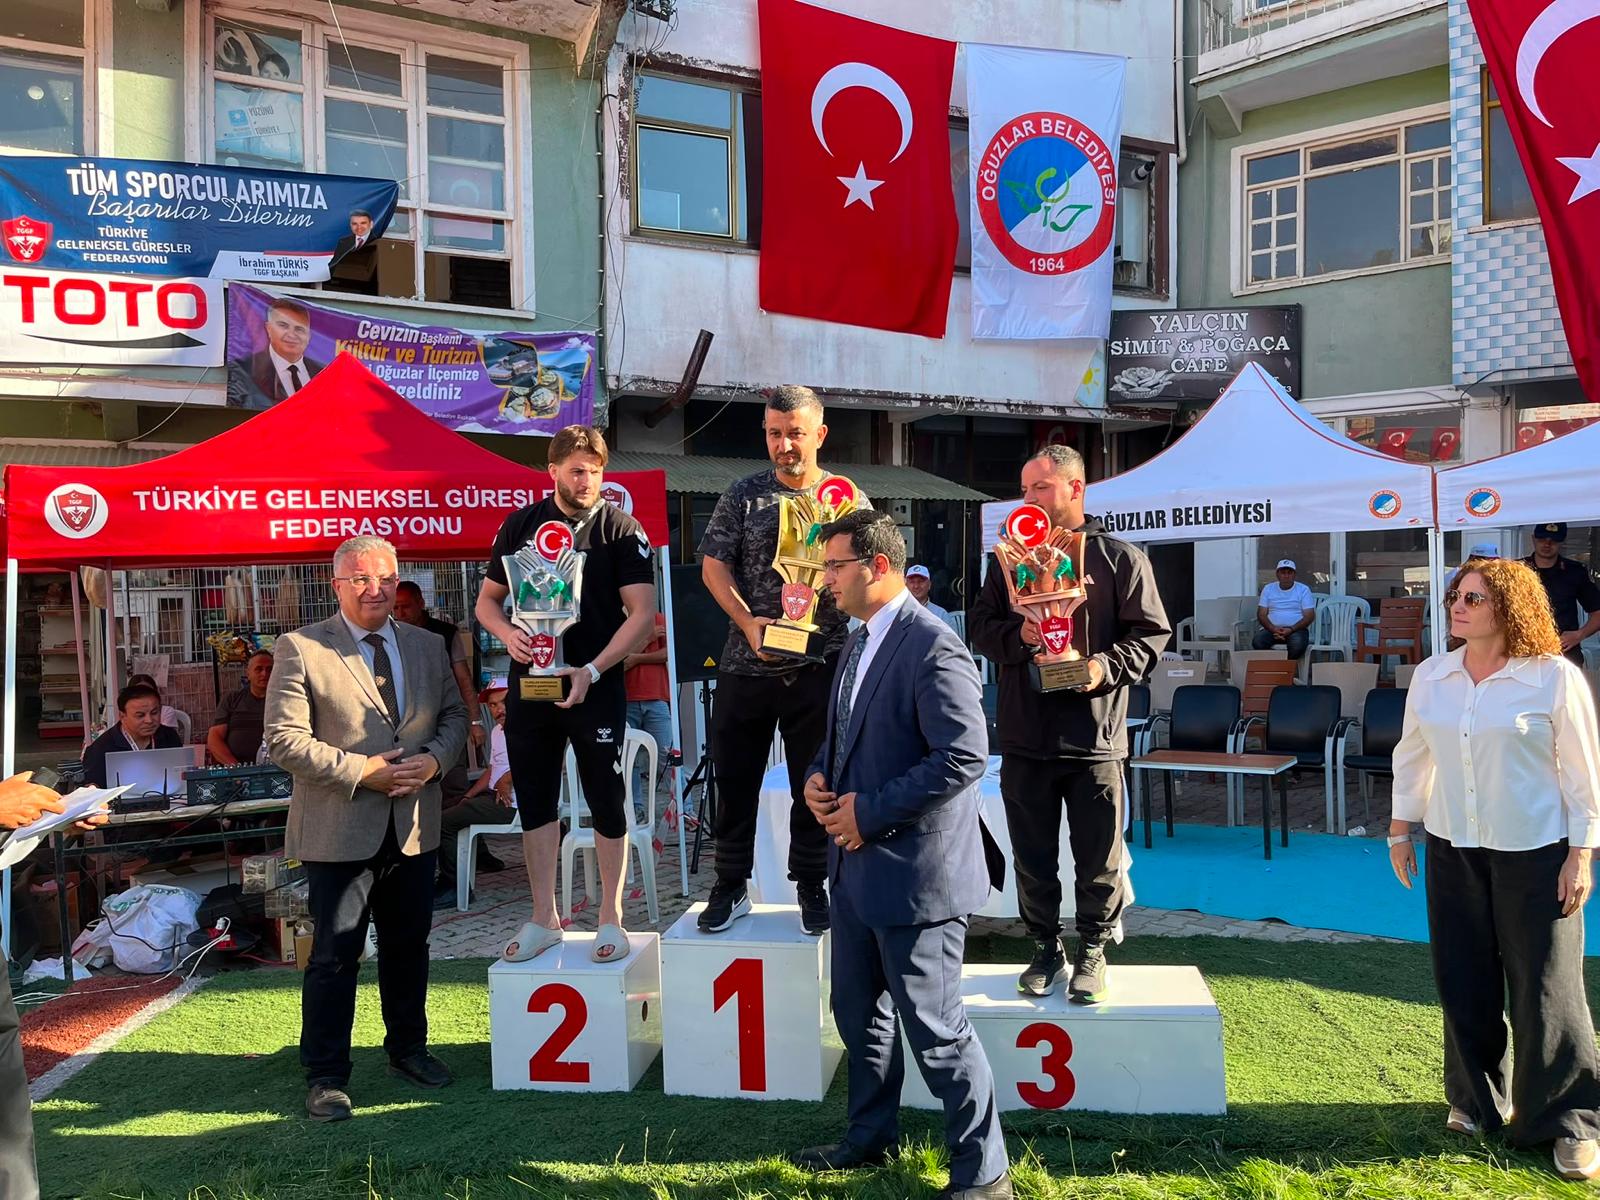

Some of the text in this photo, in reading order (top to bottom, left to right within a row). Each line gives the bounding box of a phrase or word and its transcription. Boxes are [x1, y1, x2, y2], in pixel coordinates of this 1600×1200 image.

[980, 119, 1037, 201] OĞUZLAR
[66, 162, 119, 196] TÜM
[87, 190, 315, 228] Başarılar Dilerim
[98, 225, 149, 239] TÜRKİYE
[56, 240, 192, 254] GELENEKSEL GÜREŞLER
[83, 252, 168, 265] FEDERASYONU
[239, 255, 309, 271] İbrahim TÜRKİŞ
[253, 268, 299, 278] TGGF BAŞKANI
[1029, 257, 1065, 271] 1964
[3, 274, 208, 329] TOTO
[1149, 312, 1249, 336] YALÇIN
[395, 347, 416, 363] ve
[422, 344, 478, 365] Turizm
[1110, 333, 1291, 356] SİMİT & POĞAÇA
[375, 364, 425, 381] Oğuzlar
[428, 363, 480, 383] İlçemize
[1170, 357, 1228, 373] CAFE
[389, 382, 462, 400] geldiniz
[132, 485, 555, 511] TÜRKİYE GELENEKSEL GÜREŞL
[1172, 499, 1272, 527] BELEDİYESİ
[269, 515, 463, 540] FEDERASYONU
[527, 982, 590, 1083] 2
[713, 957, 767, 1093] 1
[1015, 1021, 1077, 1111] 3
